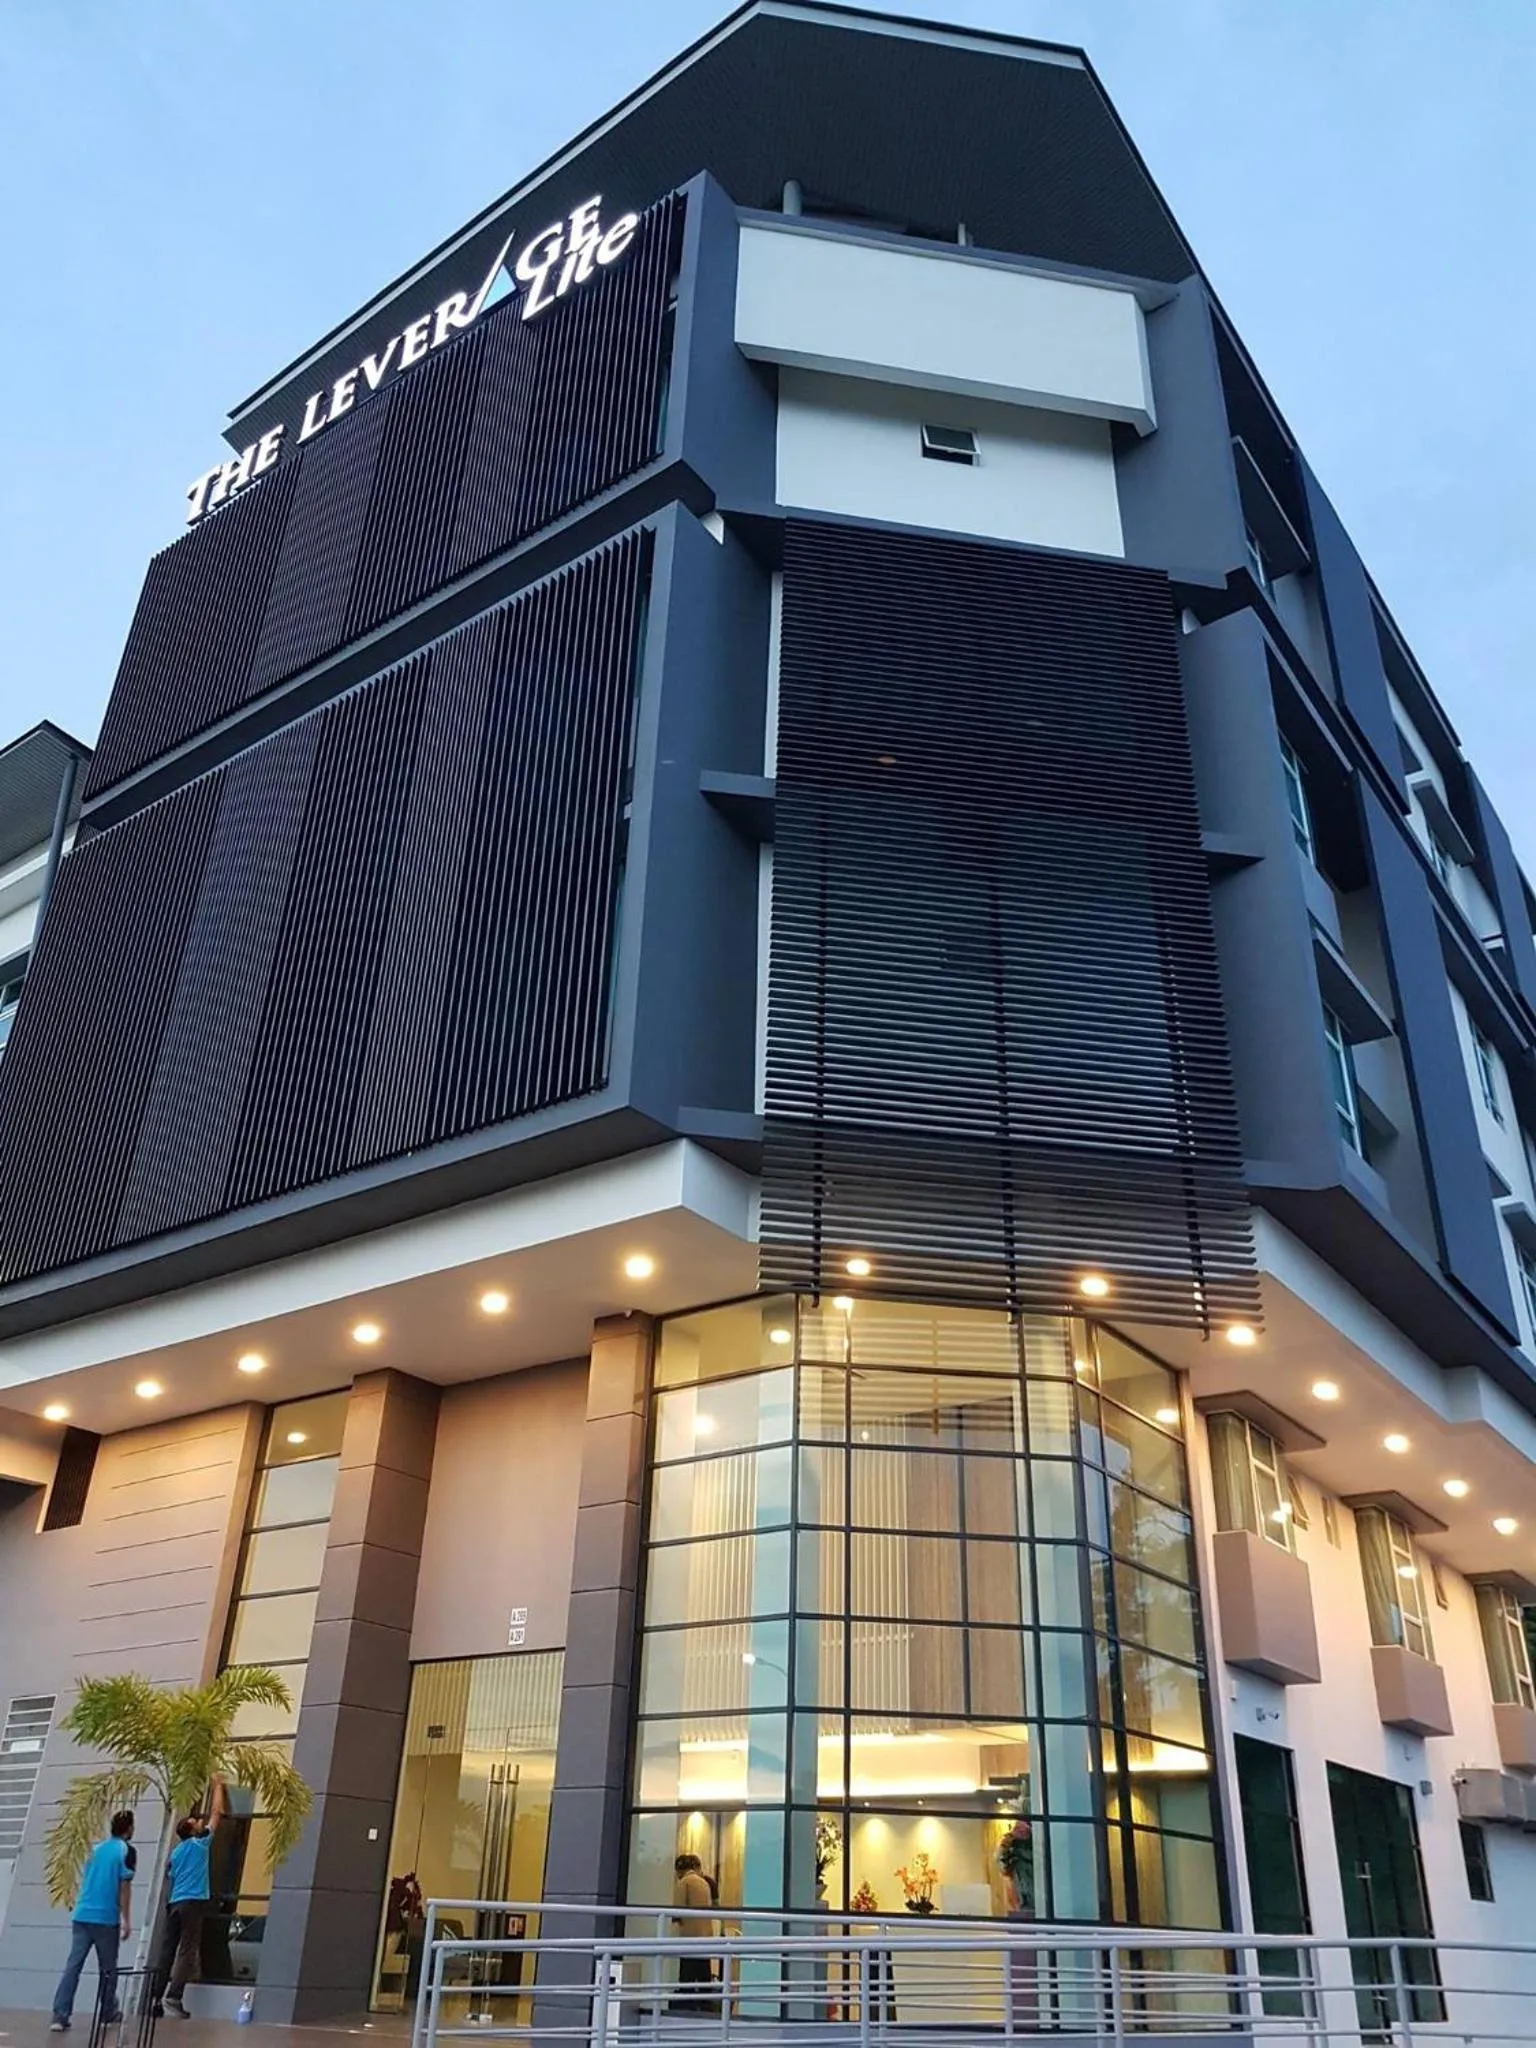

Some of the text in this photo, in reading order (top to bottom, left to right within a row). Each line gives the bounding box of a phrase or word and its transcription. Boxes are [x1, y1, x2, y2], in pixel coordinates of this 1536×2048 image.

[186, 194, 602, 523] THE LEVERAGE
[522, 212, 638, 320] Lite
